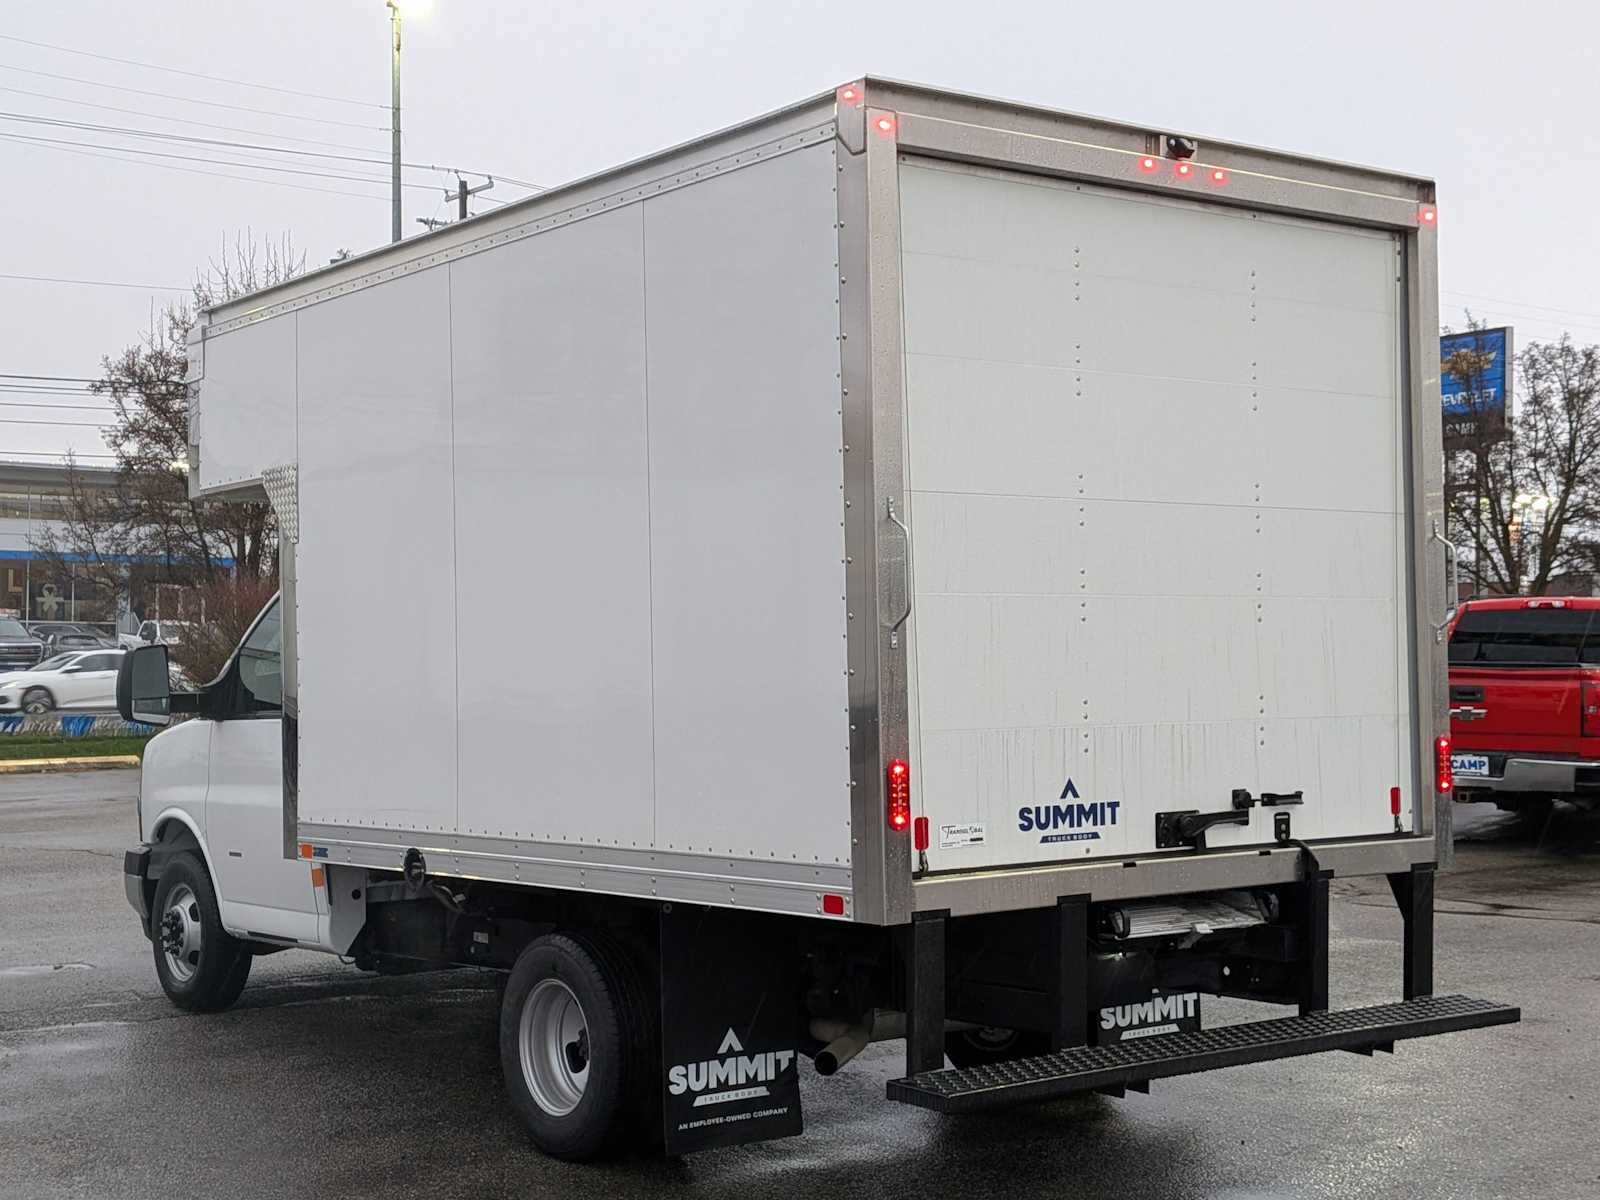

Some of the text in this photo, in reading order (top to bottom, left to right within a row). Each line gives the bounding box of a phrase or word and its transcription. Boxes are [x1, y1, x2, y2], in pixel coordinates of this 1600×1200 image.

[1451, 759, 1486, 770] CAMP
[1018, 801, 1120, 832] SUMMIT
[1100, 992, 1198, 1030] SUMMIT
[668, 1049, 795, 1095] SUMMIT
[678, 1107, 788, 1131] AN EMPLOYEE-OWNED COMPANY
